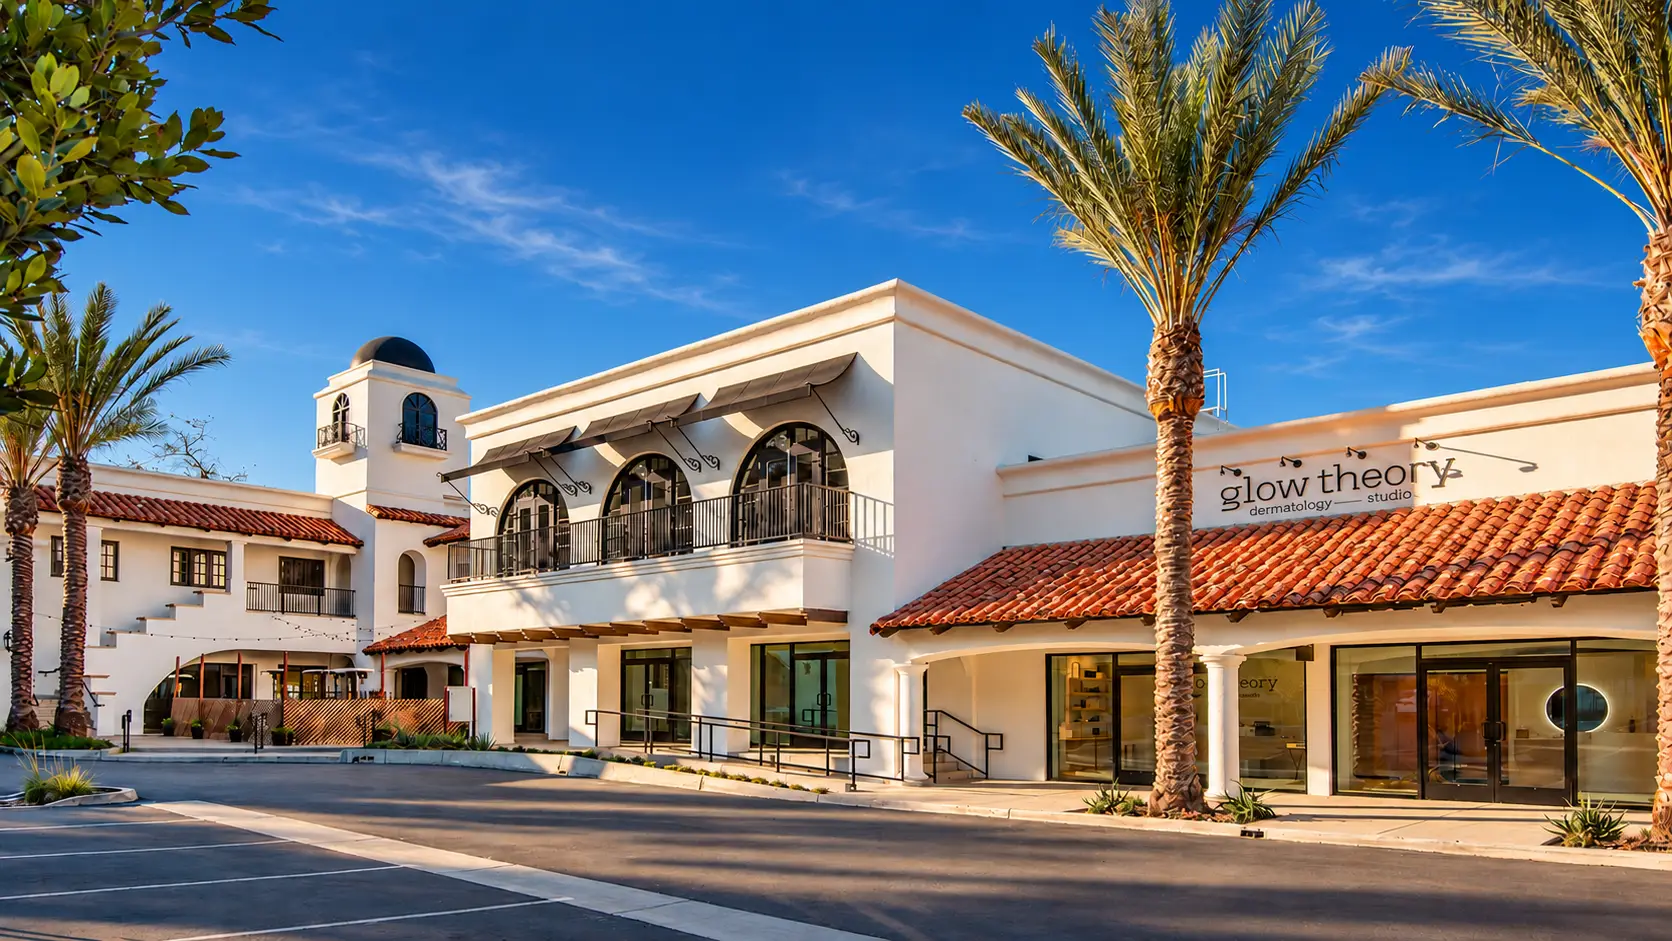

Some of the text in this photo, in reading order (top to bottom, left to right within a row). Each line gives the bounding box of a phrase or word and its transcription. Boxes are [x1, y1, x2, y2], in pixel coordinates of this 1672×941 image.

[1220, 457, 1456, 512] glow theory
[1249, 489, 1412, 516] dermatology studio
[1239, 678, 1278, 692] eory
